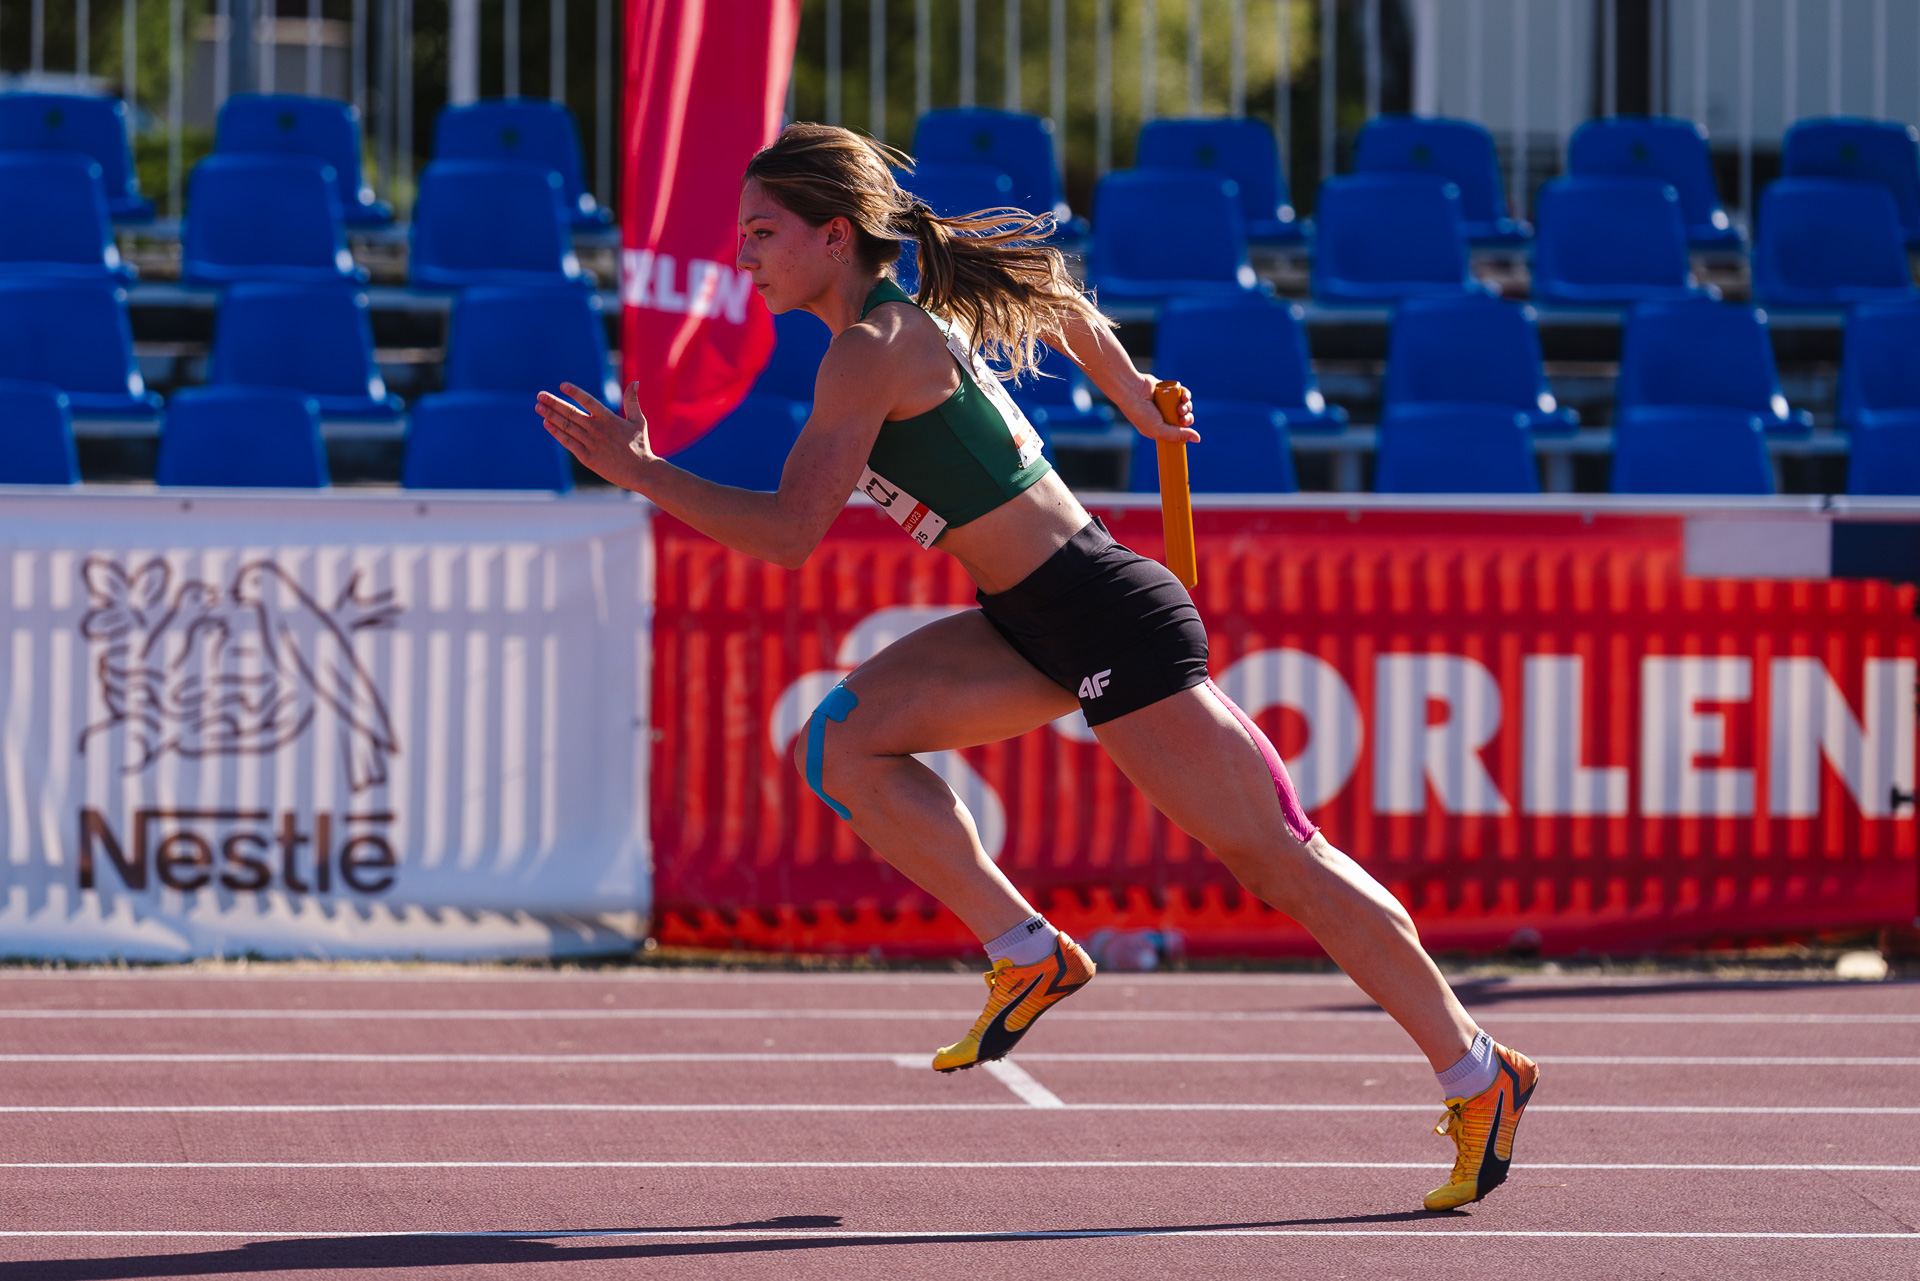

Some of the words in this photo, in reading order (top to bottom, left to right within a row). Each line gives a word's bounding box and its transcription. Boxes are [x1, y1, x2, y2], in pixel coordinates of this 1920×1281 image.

[863, 477, 899, 507] CZ
[910, 511, 922, 523] U23
[915, 531, 929, 546] 25
[1078, 668, 1112, 700] 4F
[1211, 647, 1917, 819] ORLEN
